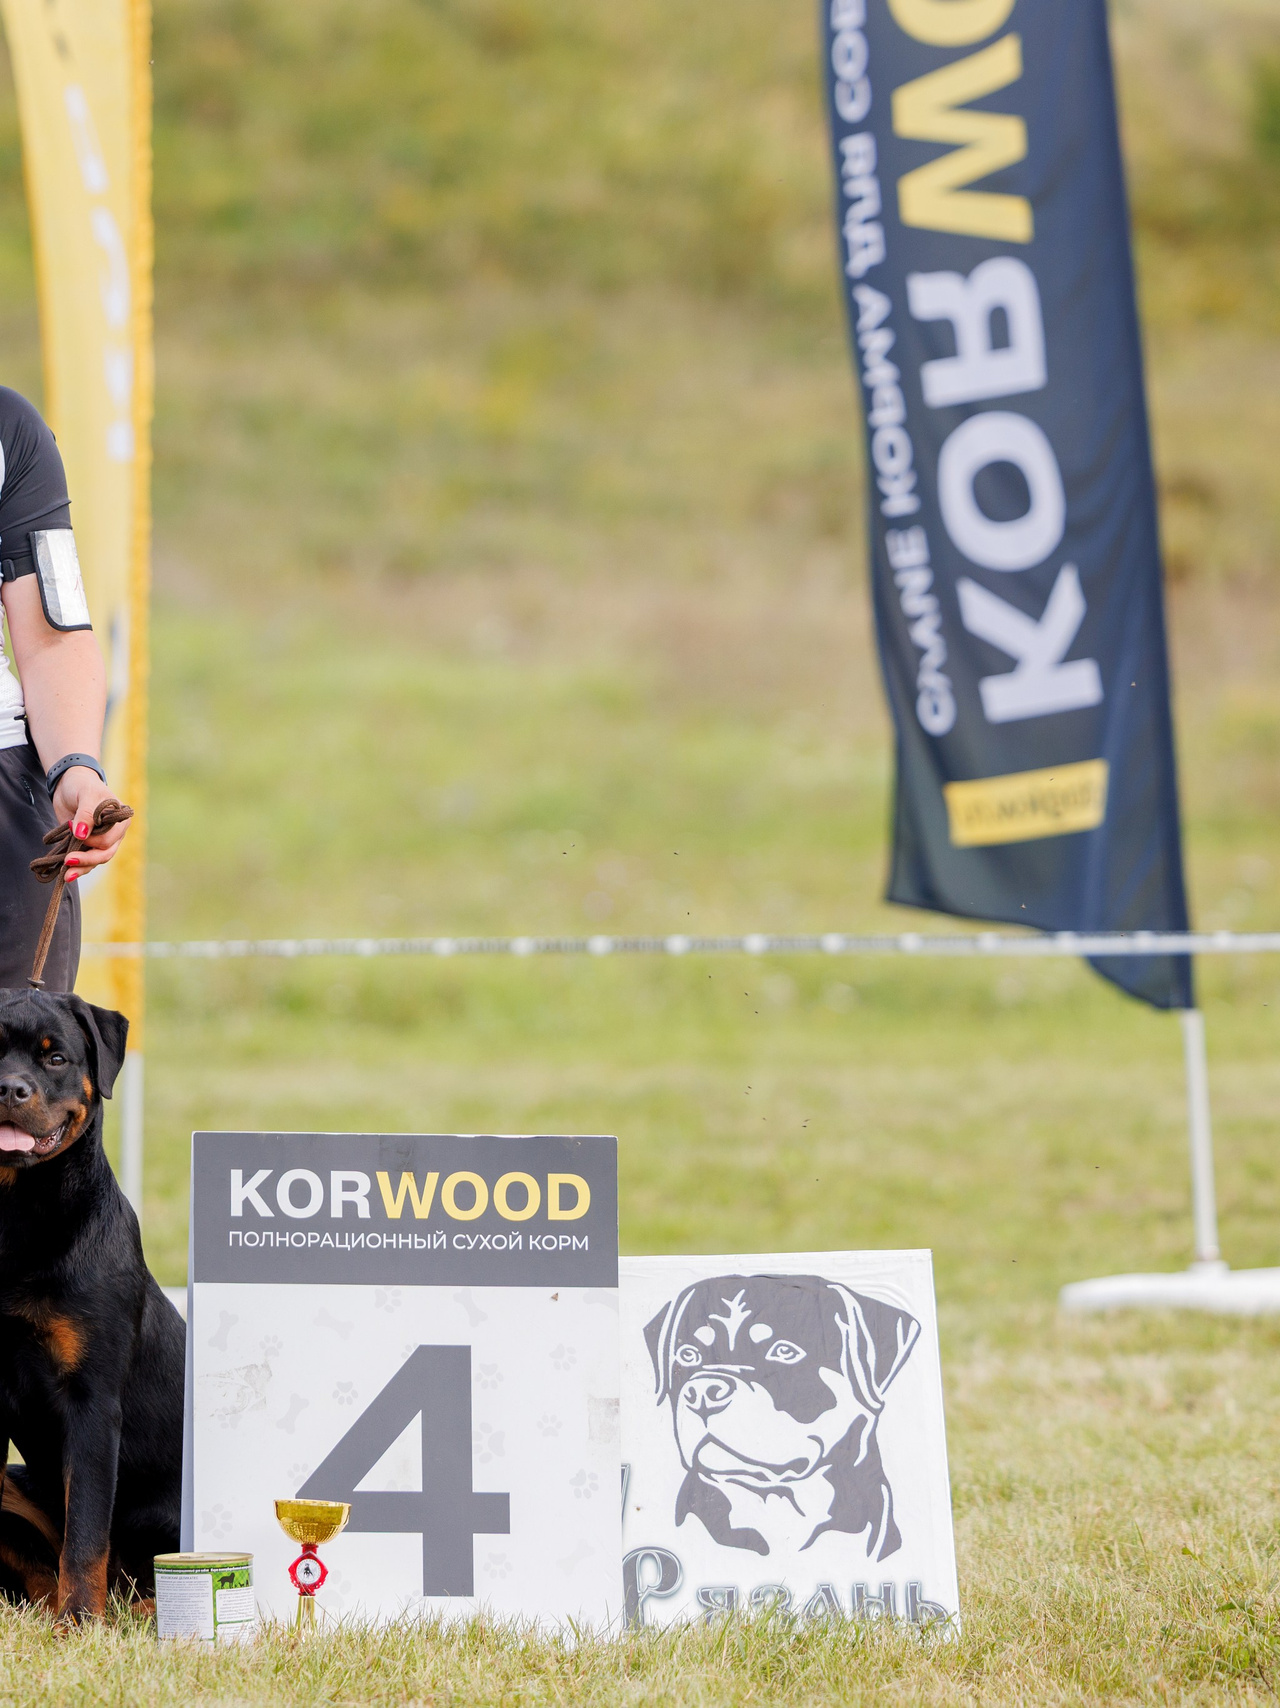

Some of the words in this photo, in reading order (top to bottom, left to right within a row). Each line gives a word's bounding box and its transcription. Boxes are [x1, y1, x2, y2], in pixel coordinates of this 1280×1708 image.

[229, 1168, 591, 1221] KORWOOD
[228, 1229, 447, 1250] ПОЛНОРАЦИОННЫЙ
[452, 1231, 523, 1250] СУХОЙ
[529, 1234, 590, 1251] КОРМ
[295, 1344, 511, 1597] 4
